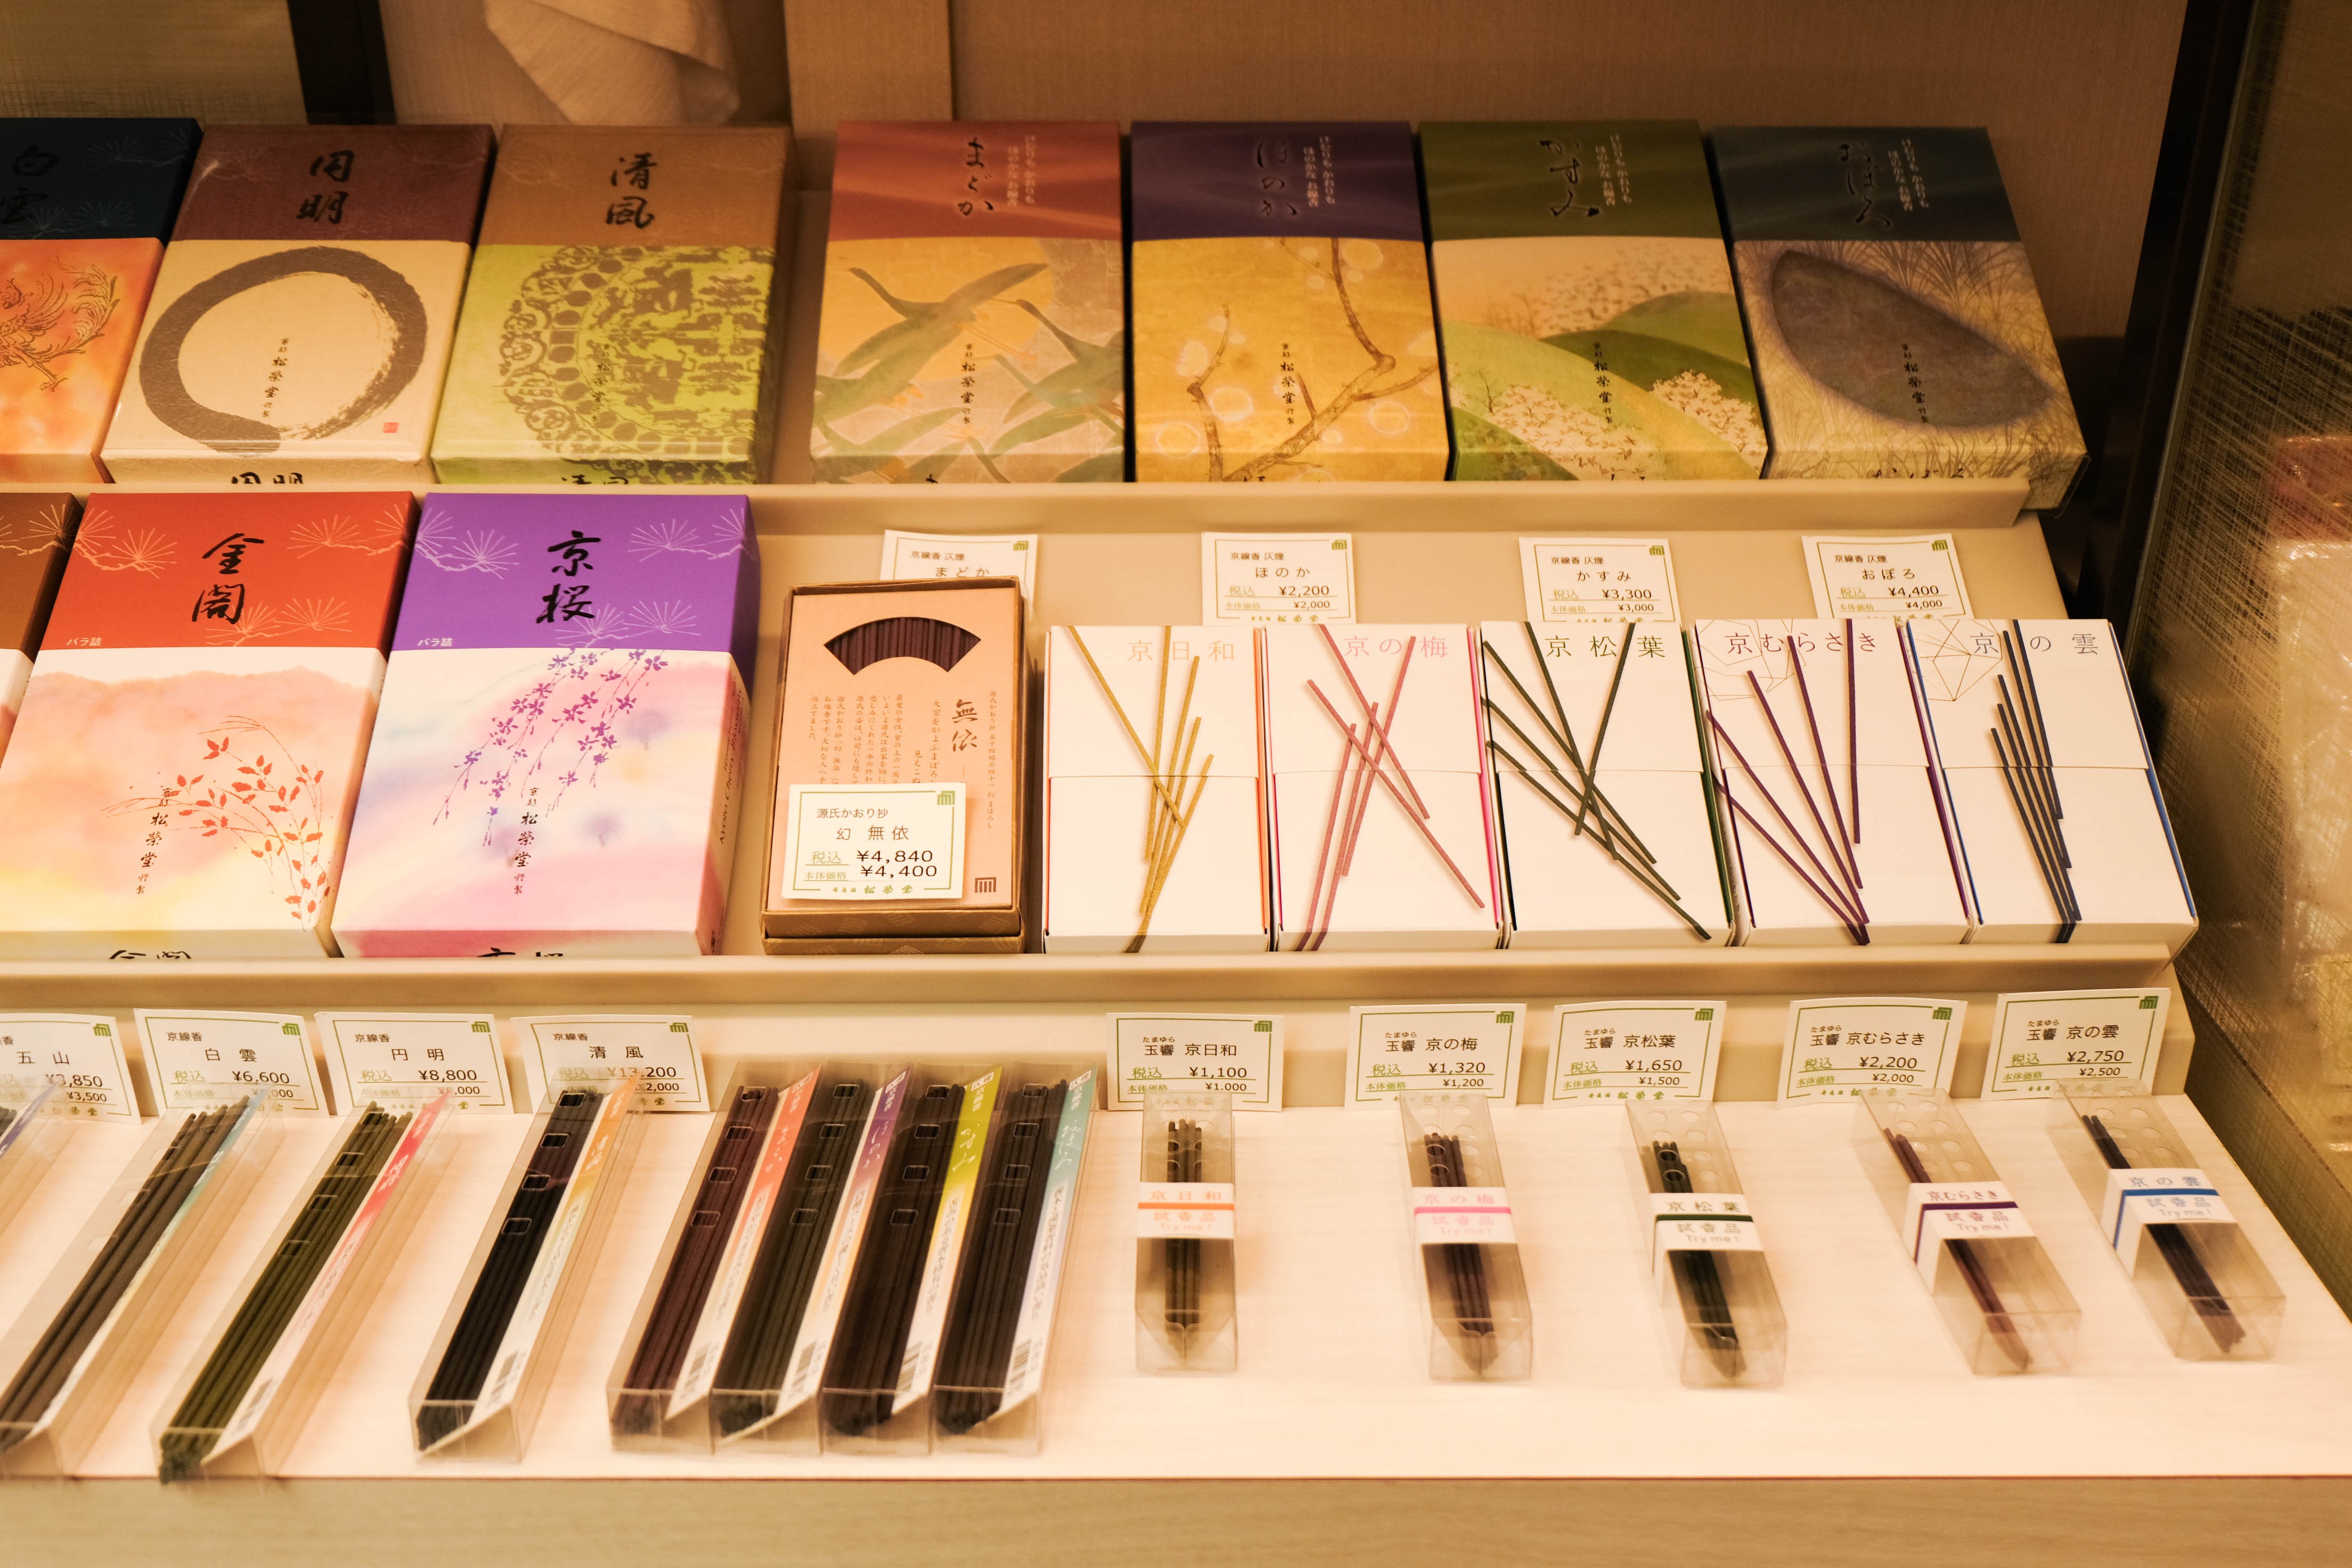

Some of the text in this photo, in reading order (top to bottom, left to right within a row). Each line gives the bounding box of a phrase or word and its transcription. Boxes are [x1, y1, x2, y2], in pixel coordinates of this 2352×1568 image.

[606, 152, 658, 229] 清風
[1230, 552, 1260, 560] 京線香
[1550, 556, 1580, 565] 京線香
[1834, 554, 1864, 563] 京線香
[536, 530, 602, 624] 京桜
[936, 567, 990, 577] まどか
[1255, 566, 1310, 578] ほのか
[1577, 570, 1631, 582] かすみ
[1862, 568, 1915, 580] おぼろ
[191, 533, 265, 625] 金閣
[1229, 585, 1329, 597] 税込 ¥2,200
[1553, 589, 1652, 600] 税込 ¥3,300
[1840, 585, 1939, 598] 税込 ¥4,400
[1293, 600, 1330, 610] ¥2,000
[1618, 603, 1654, 612] ¥3,000
[1905, 600, 1942, 609] ¥4,000
[66, 636, 103, 647] バラ詰
[417, 637, 454, 648] バラ詰
[1343, 636, 1449, 658] 京の梅
[1545, 635, 1667, 658] 京松葉
[1724, 632, 1877, 654] 京むらさき
[1969, 632, 2100, 655] 京の雲
[1127, 640, 1235, 662] 京日和
[952, 699, 978, 752] 無依
[928, 700, 942, 782] 大空をかよふまぼろ
[816, 808, 889, 819] 源氏かおり抄
[836, 825, 910, 841] 幻 無依
[811, 850, 933, 864] 税込 ¥4,840
[805, 865, 937, 880] 本体価格 ¥4,400
[166, 1031, 203, 1042] 京線香
[354, 1033, 390, 1043] 京線香
[552, 1033, 589, 1041] 京線香
[1810, 1031, 1925, 1046] 玉響 京むらさき
[2027, 1024, 2119, 1041] 玉響 京の雲
[1385, 1037, 1478, 1052] 玉響 京の梅
[1583, 1034, 1677, 1049] 玉響 京松葉
[205, 1048, 257, 1063] 白雲
[391, 1048, 444, 1061] 円明
[589, 1046, 644, 1059] 清風
[1145, 1043, 1237, 1056] 玉響 京日和
[17, 1051, 70, 1065] 五山
[1804, 1056, 1917, 1069] 税込 ¥2,200
[2011, 1050, 2124, 1066] 税込 ¥2,750
[1132, 1066, 1247, 1079] 税込 ¥1,100
[1372, 1062, 1485, 1076] 税込 ¥1,320
[1570, 1059, 1683, 1074] 税込 ¥1,650
[174, 1069, 290, 1085] 税込 ¥6,600
[362, 1069, 477, 1082] 税込 ¥8,800
[1796, 1073, 1914, 1086] 本体価格 ¥2,000
[2003, 1067, 2121, 1082] 本体価格 ¥2,500
[1128, 1083, 1247, 1092] 本体価格 ¥1,000
[1366, 1079, 1484, 1091] 本体価格 ¥1,200
[1564, 1077, 1680, 1089] 本体価格 ¥1,500
[66, 1091, 107, 1102] ¥3,500
[2127, 1176, 2202, 1187] 京の雲
[1150, 1190, 1221, 1201] 京日和
[1424, 1194, 1495, 1205] 京の梅
[1926, 1190, 1998, 1201] 京むらさき
[1665, 1201, 1742, 1212] 京松葉
